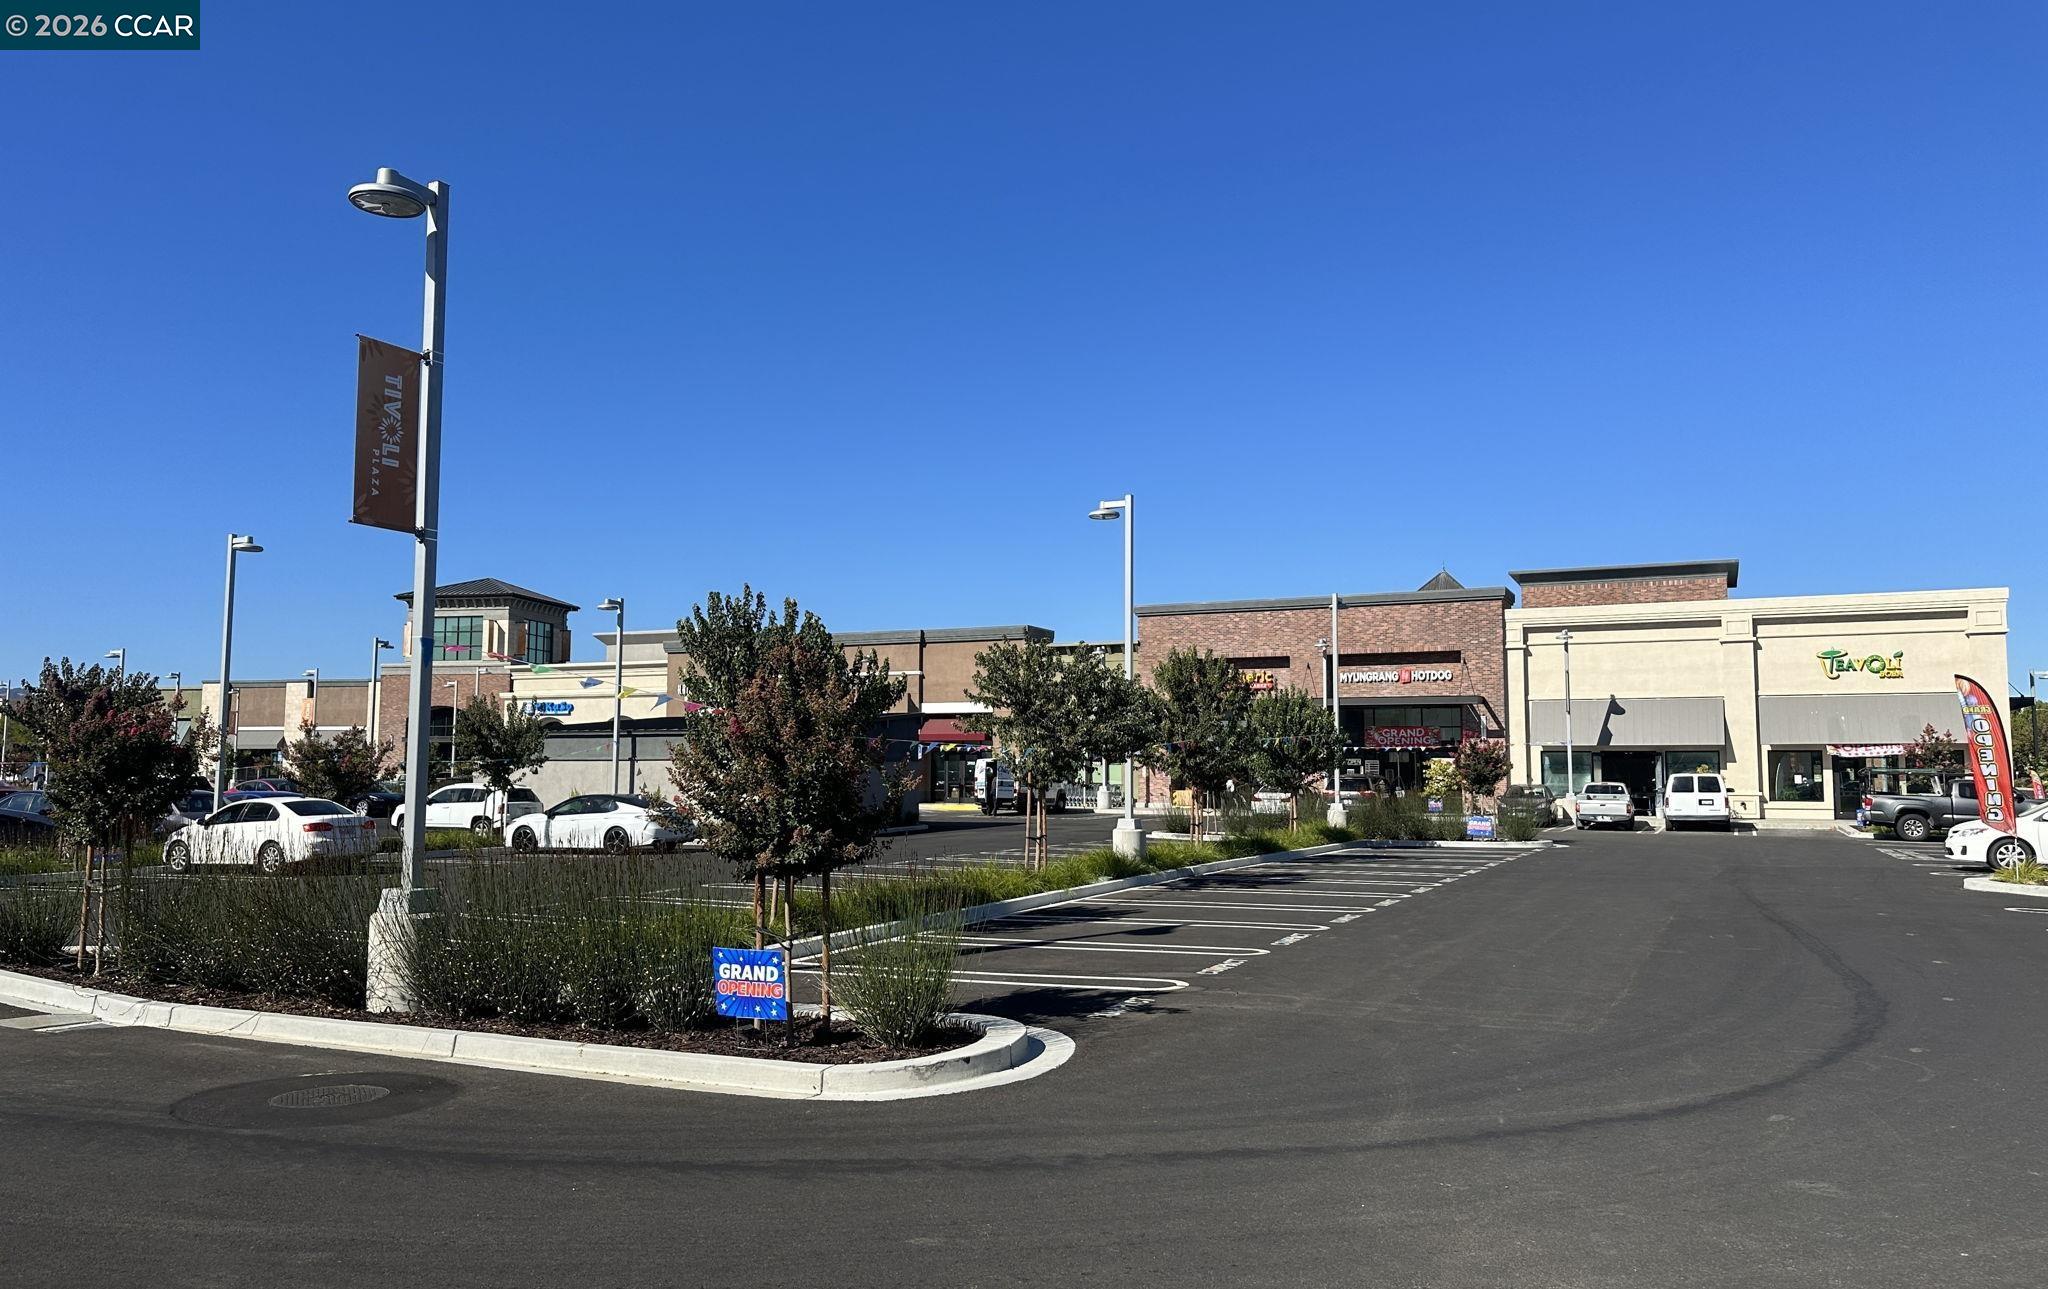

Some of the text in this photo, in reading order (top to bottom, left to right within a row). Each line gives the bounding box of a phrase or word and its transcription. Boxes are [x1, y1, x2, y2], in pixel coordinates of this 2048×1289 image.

[371, 448, 380, 496] PLAZA
[1339, 671, 1400, 683] MYUNGRANG
[1411, 670, 1453, 682] HOTDOG
[1378, 736, 1432, 745] OPENING
[1382, 728, 1424, 738] GRAND
[719, 963, 778, 981] GRAND
[718, 980, 783, 998] OPENING
